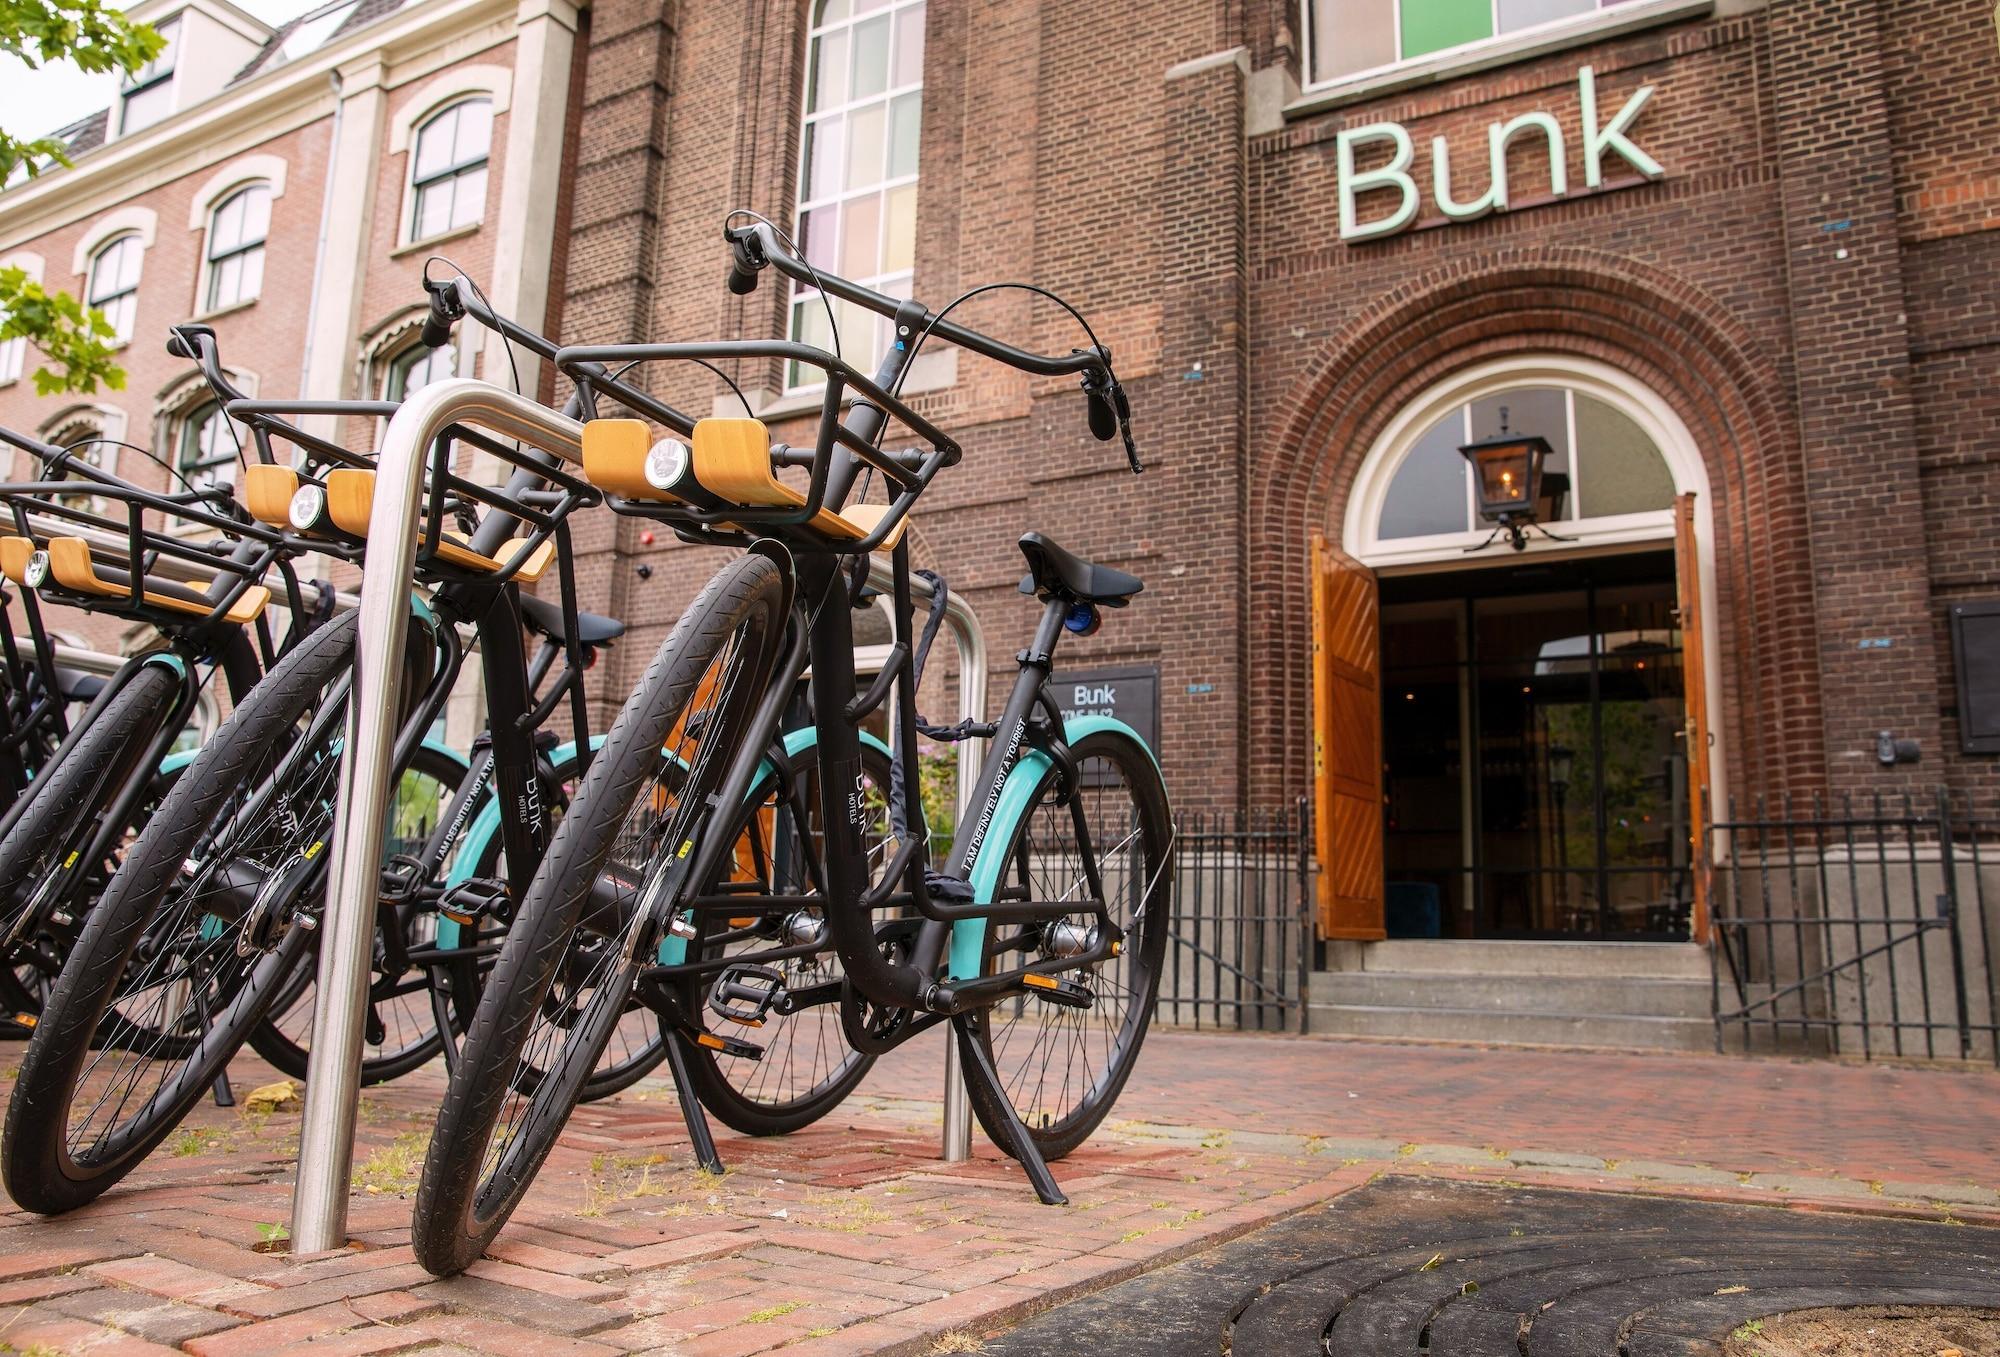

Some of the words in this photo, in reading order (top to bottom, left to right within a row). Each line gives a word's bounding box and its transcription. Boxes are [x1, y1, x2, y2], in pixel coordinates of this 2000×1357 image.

[1337, 65, 1665, 243] Bunk
[1074, 684, 1116, 705] Bunk
[1006, 717, 1026, 761] TOURIST
[995, 768, 1008, 788] NOT
[1003, 759, 1011, 769] A
[438, 840, 451, 857] AM
[446, 796, 474, 840] DEFINITELY
[472, 777, 485, 797] NOT
[481, 772, 489, 780] A
[518, 794, 527, 824] HOTELS
[526, 776, 542, 834] Bunk
[848, 792, 857, 824] HOTELS
[974, 790, 1000, 848] DEFINITELY
[966, 844, 980, 864] AM
